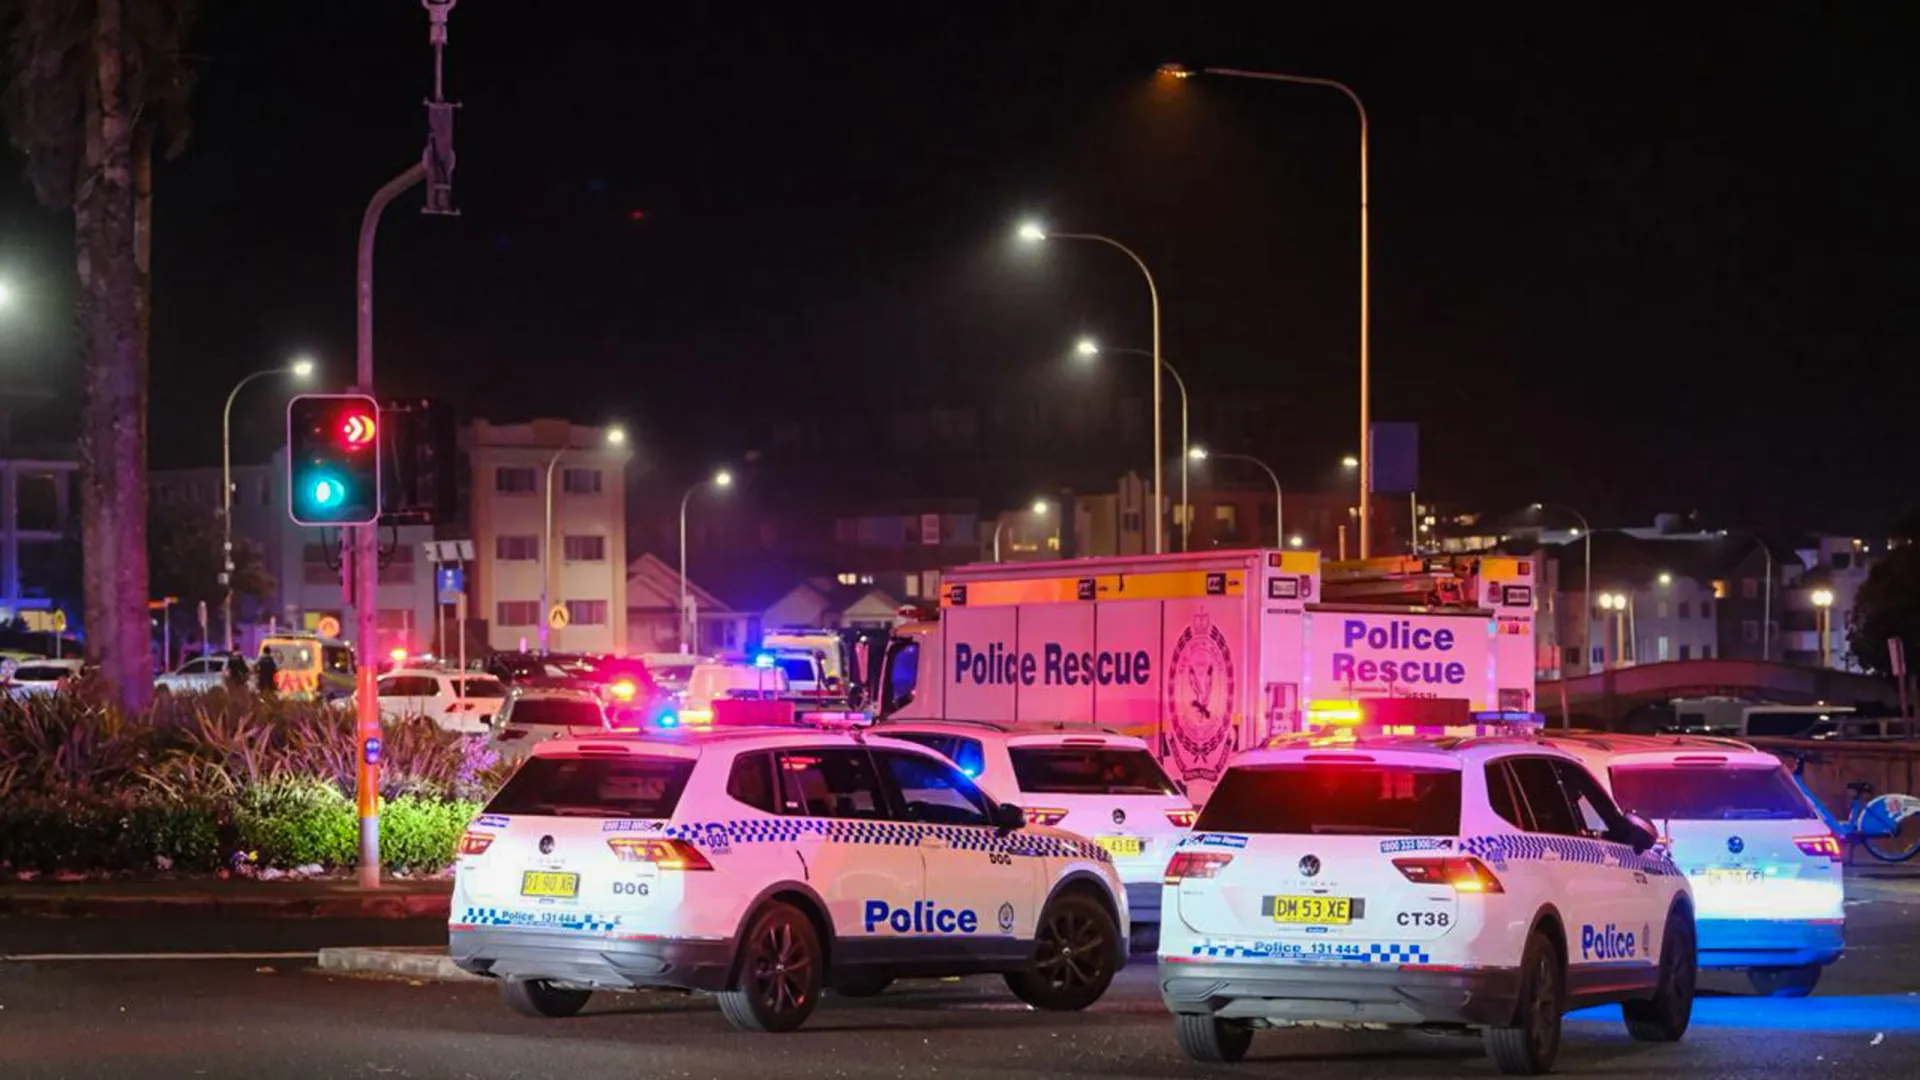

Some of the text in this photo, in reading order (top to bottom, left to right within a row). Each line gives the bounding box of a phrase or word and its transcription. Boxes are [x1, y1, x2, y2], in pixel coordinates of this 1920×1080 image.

[1344, 620, 1454, 650] Police
[955, 642, 1150, 685] Police Rescue
[1332, 653, 1465, 685] Rescue
[989, 853, 1012, 865] DOG
[613, 882, 649, 895] DOG
[502, 911, 535, 921] Police
[865, 900, 978, 933] Police
[1277, 899, 1347, 918] DM 53 XE
[1396, 912, 1449, 926] CT38
[1254, 941, 1301, 953] Police
[1582, 923, 1636, 960] Police
